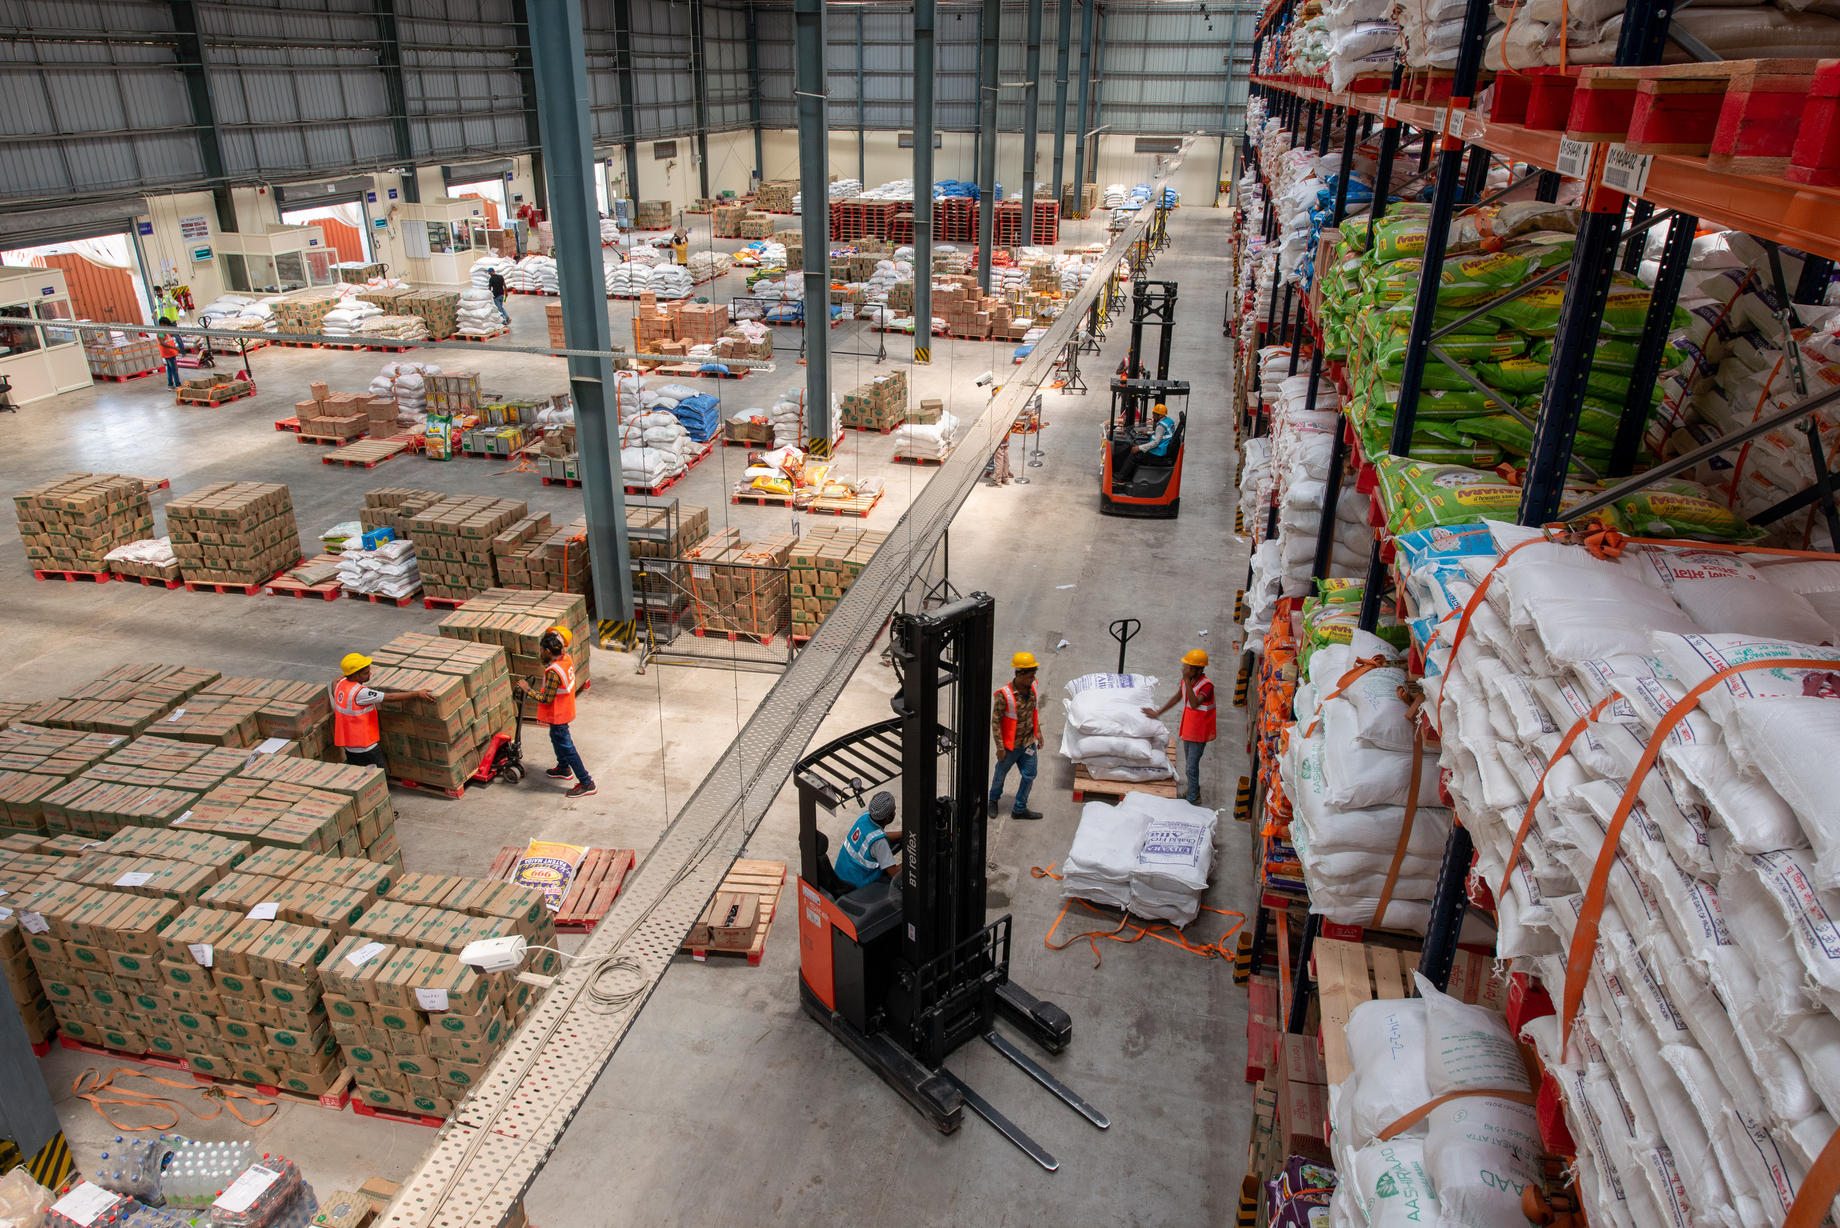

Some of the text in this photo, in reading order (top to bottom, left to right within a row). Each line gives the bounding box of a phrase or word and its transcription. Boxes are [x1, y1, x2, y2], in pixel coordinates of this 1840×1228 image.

[1650, 495, 1721, 510] MAHARAJ
[1763, 649, 1792, 658] (WHEN
[493, 681, 507, 692] Fortune
[446, 689, 462, 702] Fortune
[264, 719, 289, 728] Fortune
[453, 736, 469, 750] Fortune
[248, 759, 265, 771] Fortune
[364, 782, 382, 798] Fortune
[320, 793, 341, 801] Fortune
[226, 826, 250, 834] Fortune
[376, 835, 393, 851] Fortune
[543, 858, 567, 867] PATENT
[908, 831, 917, 888] BT reflex
[1292, 1044, 1302, 1073] Fortune
[1466, 1133, 1523, 1156] WHEAT ATTA
